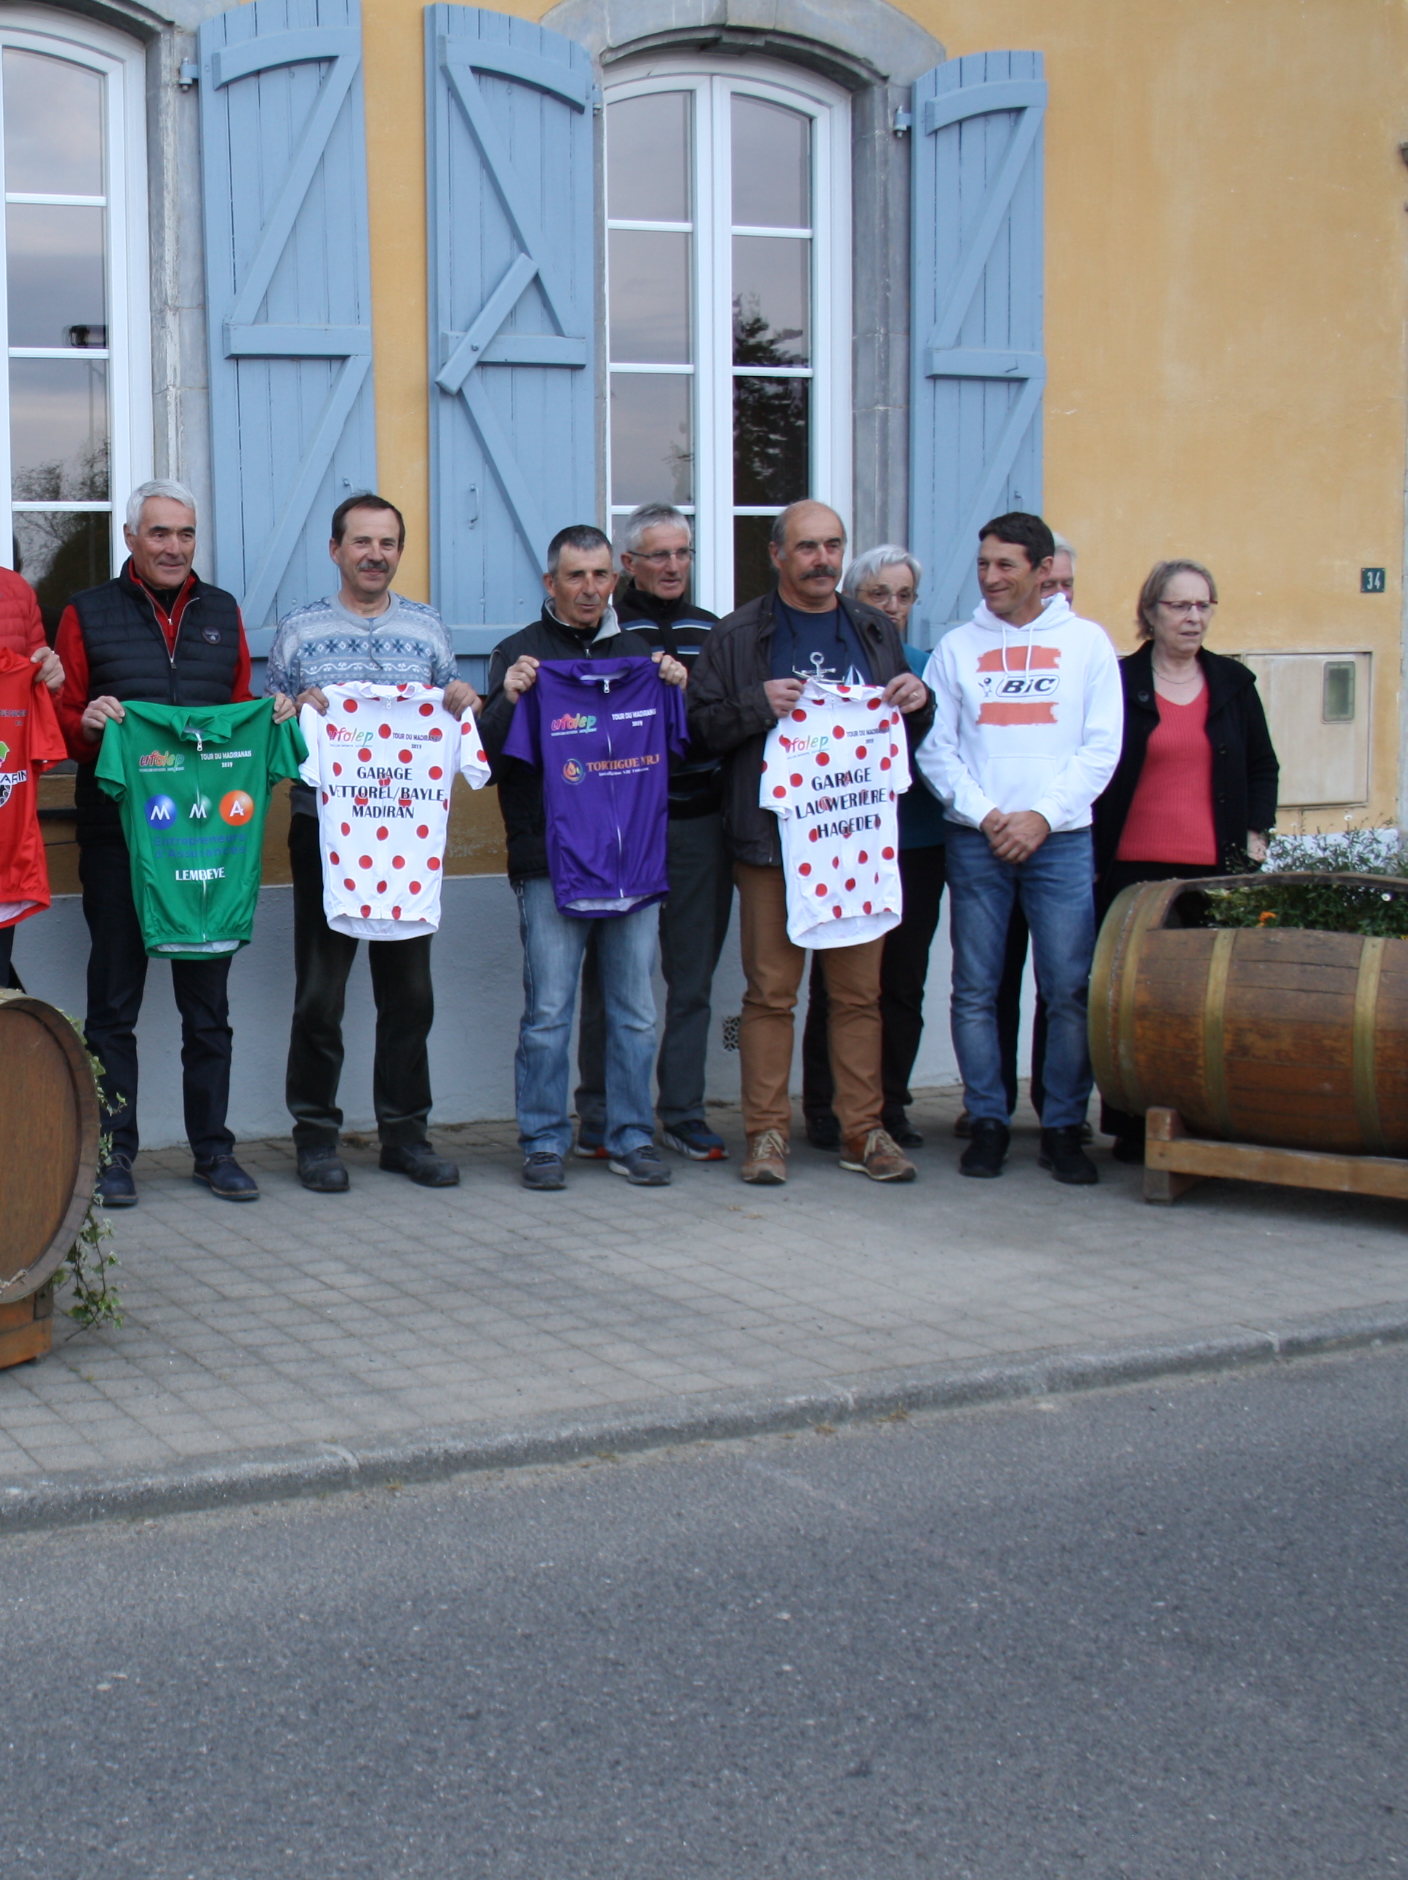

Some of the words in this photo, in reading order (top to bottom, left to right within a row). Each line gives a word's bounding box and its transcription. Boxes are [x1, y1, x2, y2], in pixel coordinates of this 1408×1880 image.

[1367, 571, 1381, 590] 34
[551, 713, 597, 733] ufolep
[611, 713, 624, 721] TOUR
[624, 712, 633, 720] DU
[392, 732, 405, 740] TOUR
[139, 750, 184, 768] ufolep
[200, 752, 214, 760] TOUR
[357, 766, 413, 781] GARAGE
[811, 767, 872, 791] GARAGE
[150, 805, 170, 820] M
[189, 803, 207, 819] M
[229, 800, 244, 817] A
[352, 805, 415, 819] MADIRAN
[817, 813, 881, 839] HAGEDET
[175, 867, 225, 881] LEMBEYE
